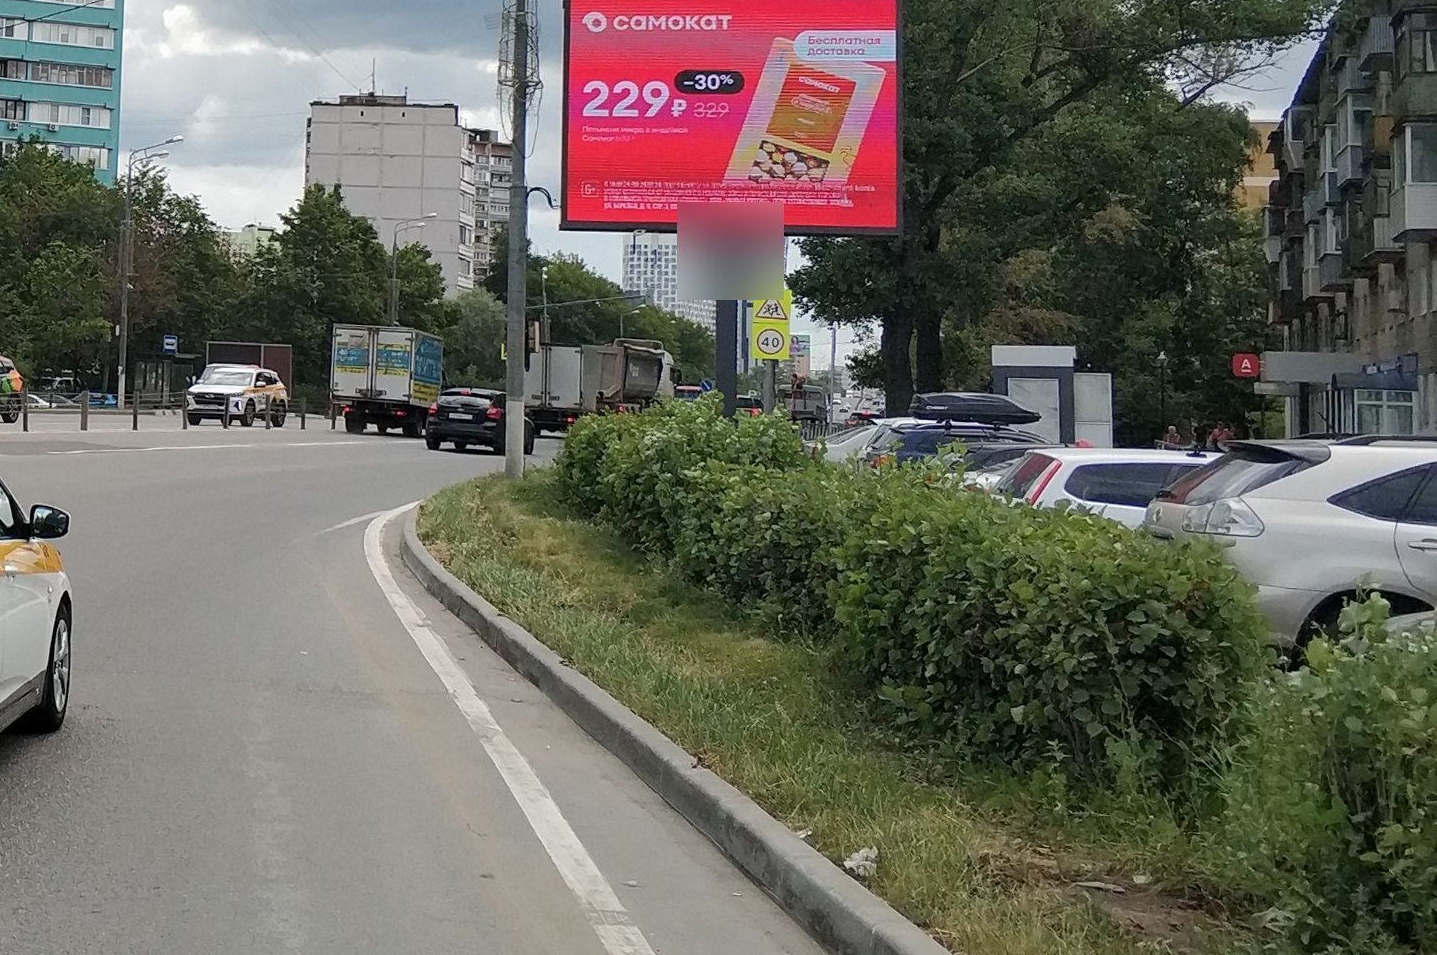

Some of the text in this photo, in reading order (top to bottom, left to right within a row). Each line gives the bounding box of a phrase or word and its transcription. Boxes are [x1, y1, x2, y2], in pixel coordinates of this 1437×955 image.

[613, 14, 732, 31] самокат
[807, 36, 881, 45] Бесплатная
[807, 47, 865, 57] доставка
[693, 102, 730, 118] 329
[761, 337, 779, 348] 40
